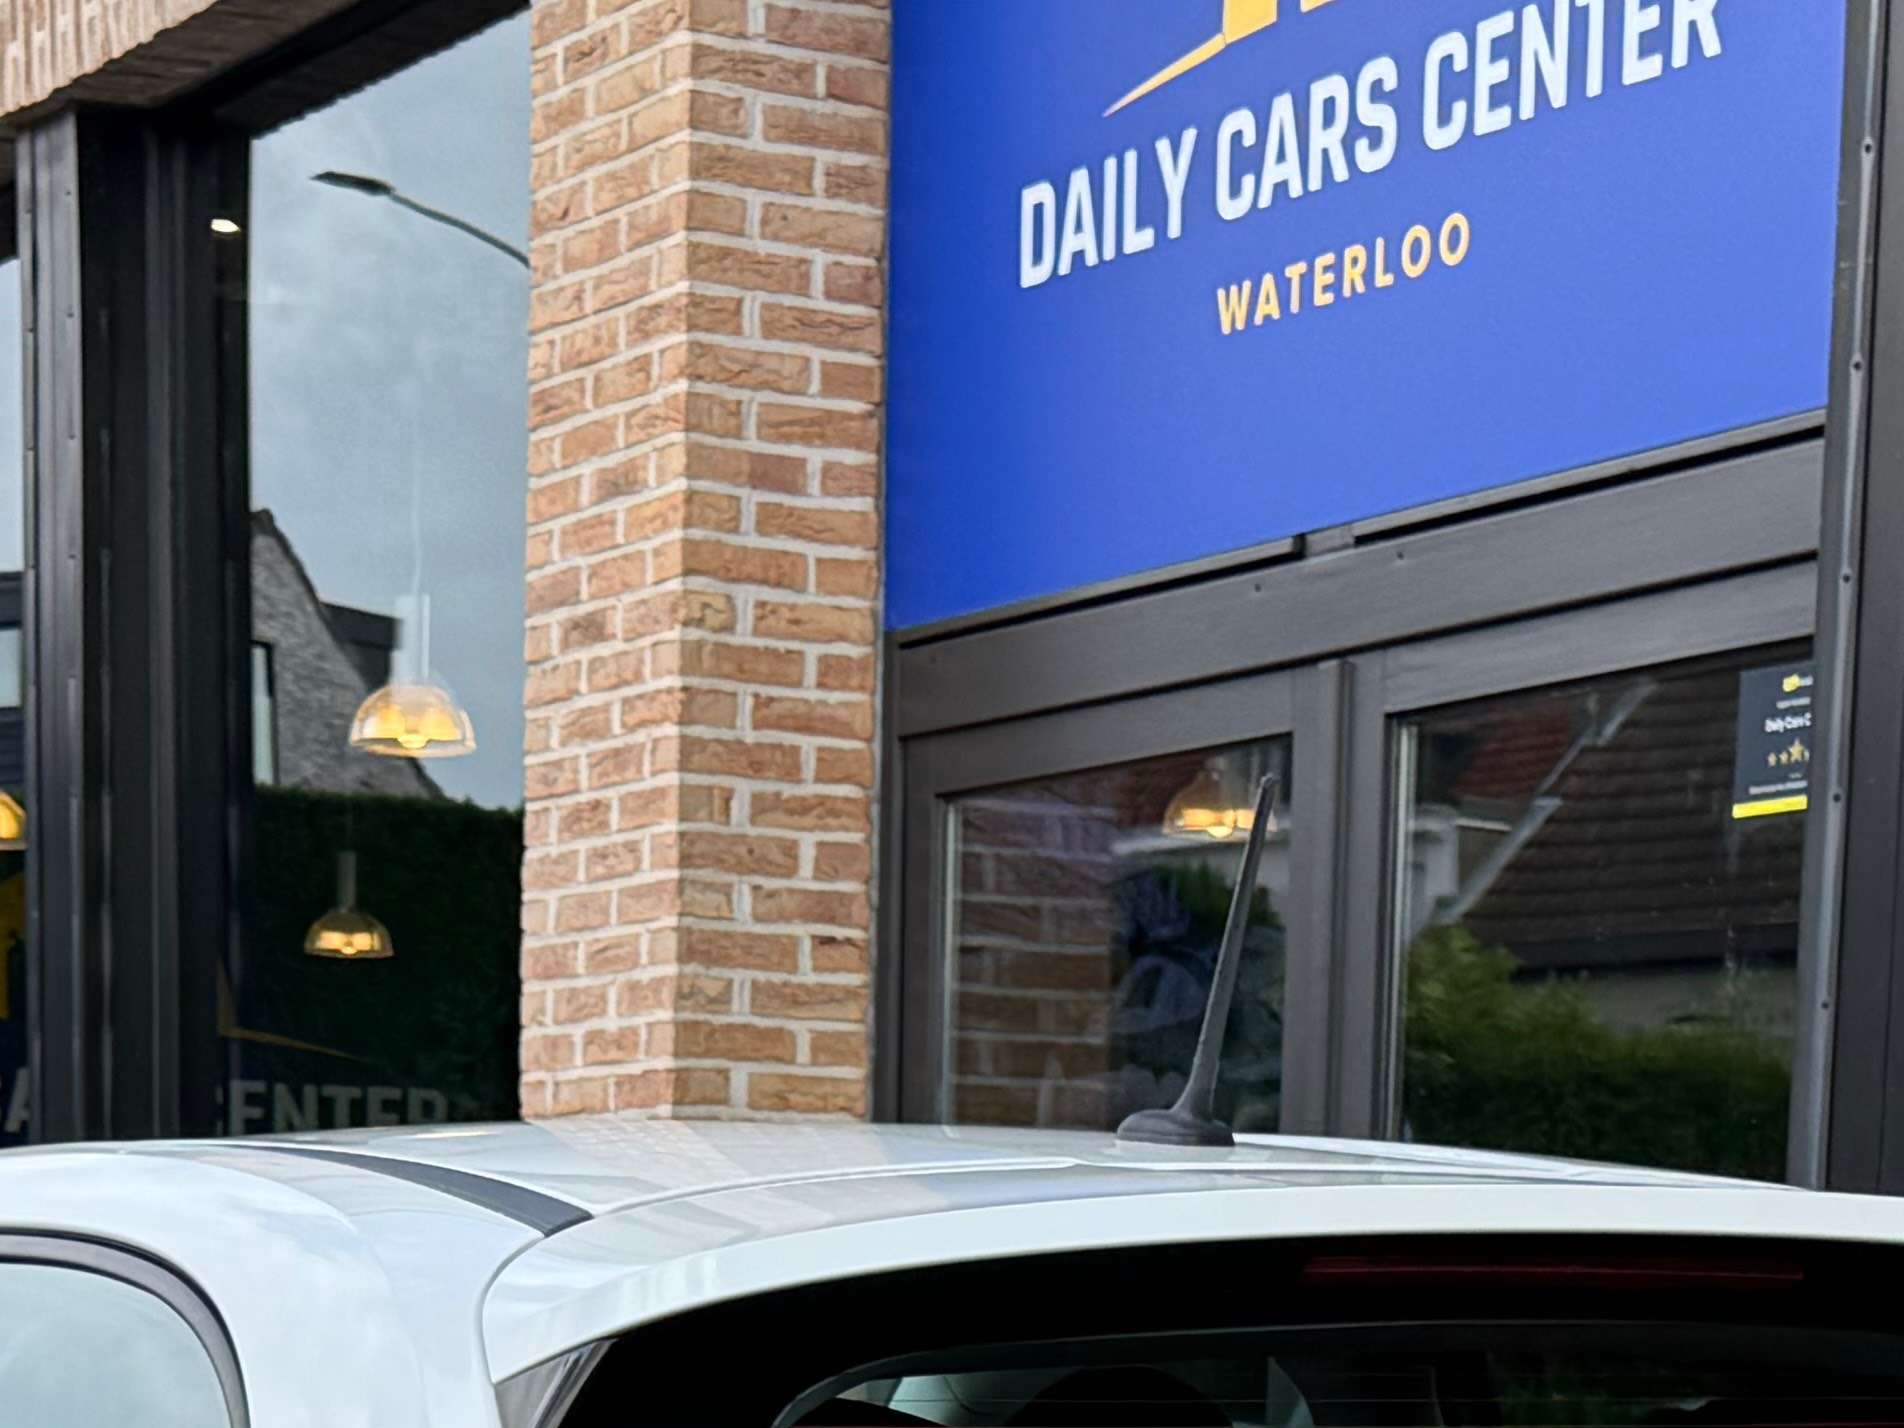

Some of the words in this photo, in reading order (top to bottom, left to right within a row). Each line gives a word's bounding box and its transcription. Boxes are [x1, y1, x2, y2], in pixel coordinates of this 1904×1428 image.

[1020, 127, 1197, 289] DAILY
[1216, 55, 1399, 221] CARS
[1423, 0, 1722, 150] CENTER
[1217, 212, 1470, 335] WATERLOO
[216, 1079, 447, 1138] ENTER
